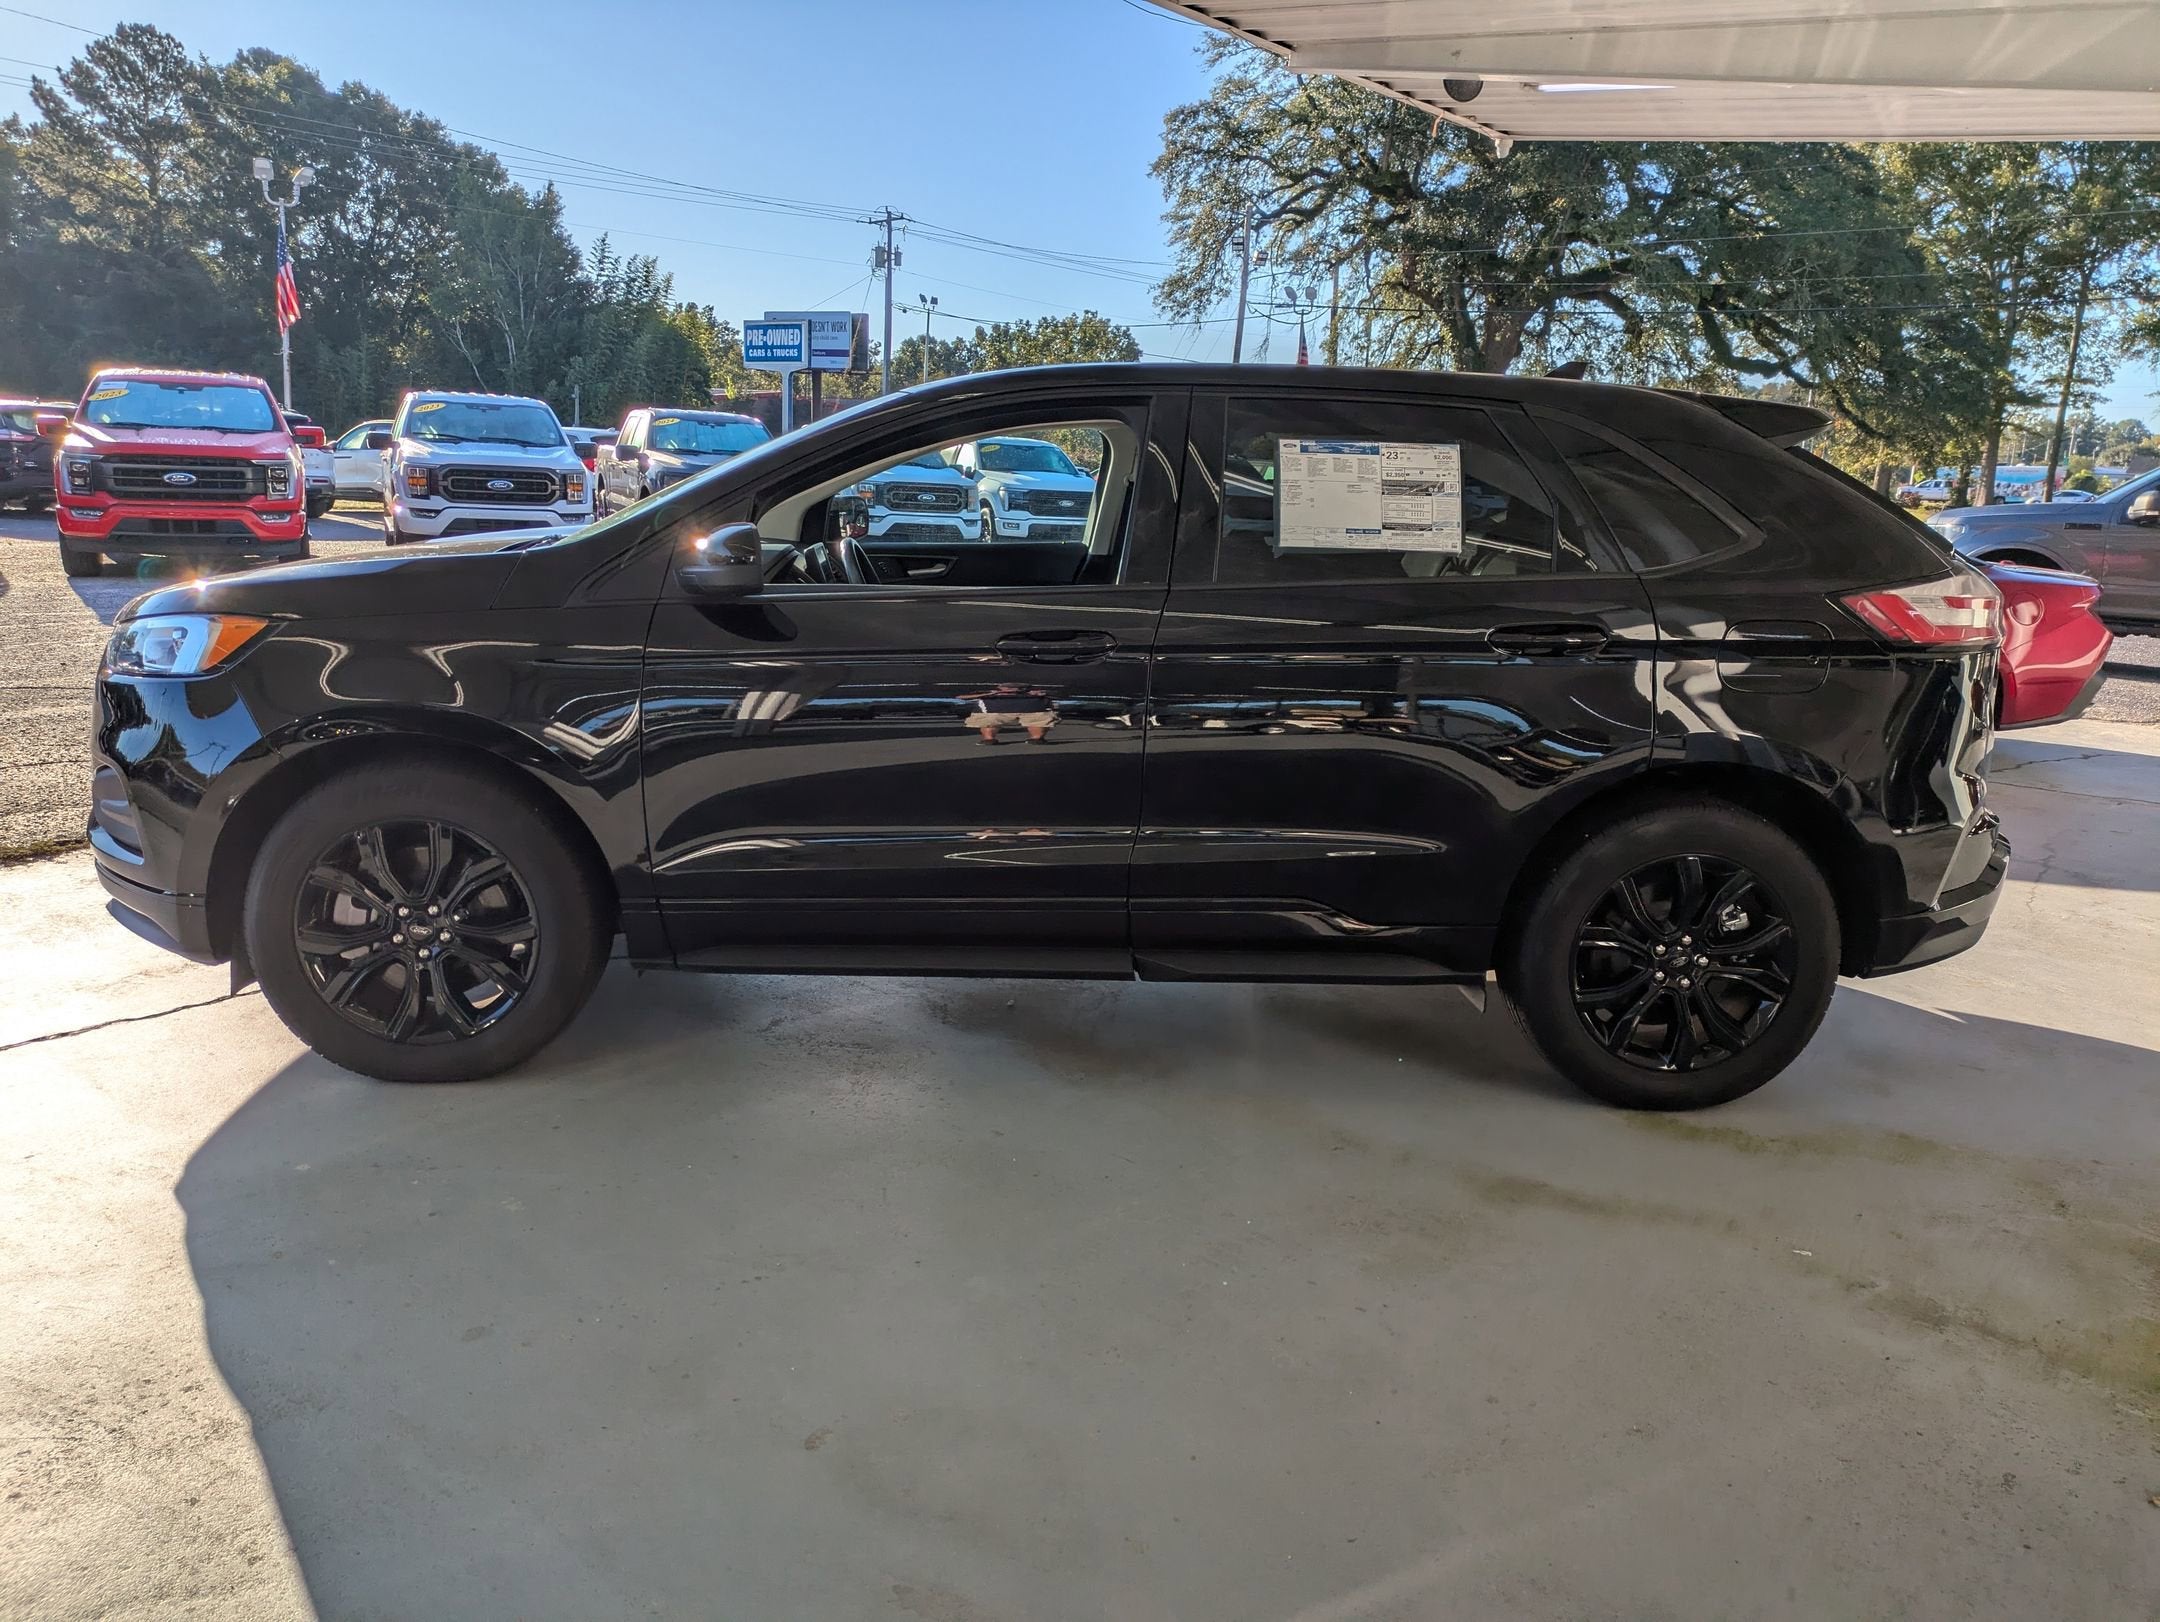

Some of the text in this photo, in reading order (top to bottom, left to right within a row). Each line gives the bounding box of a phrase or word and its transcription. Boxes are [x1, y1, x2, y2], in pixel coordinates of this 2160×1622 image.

[831, 321, 848, 332] WORK
[746, 328, 800, 346] PRE-OWNED
[749, 349, 798, 357] CARS & TRUCKS
[1386, 451, 1399, 460] 23
